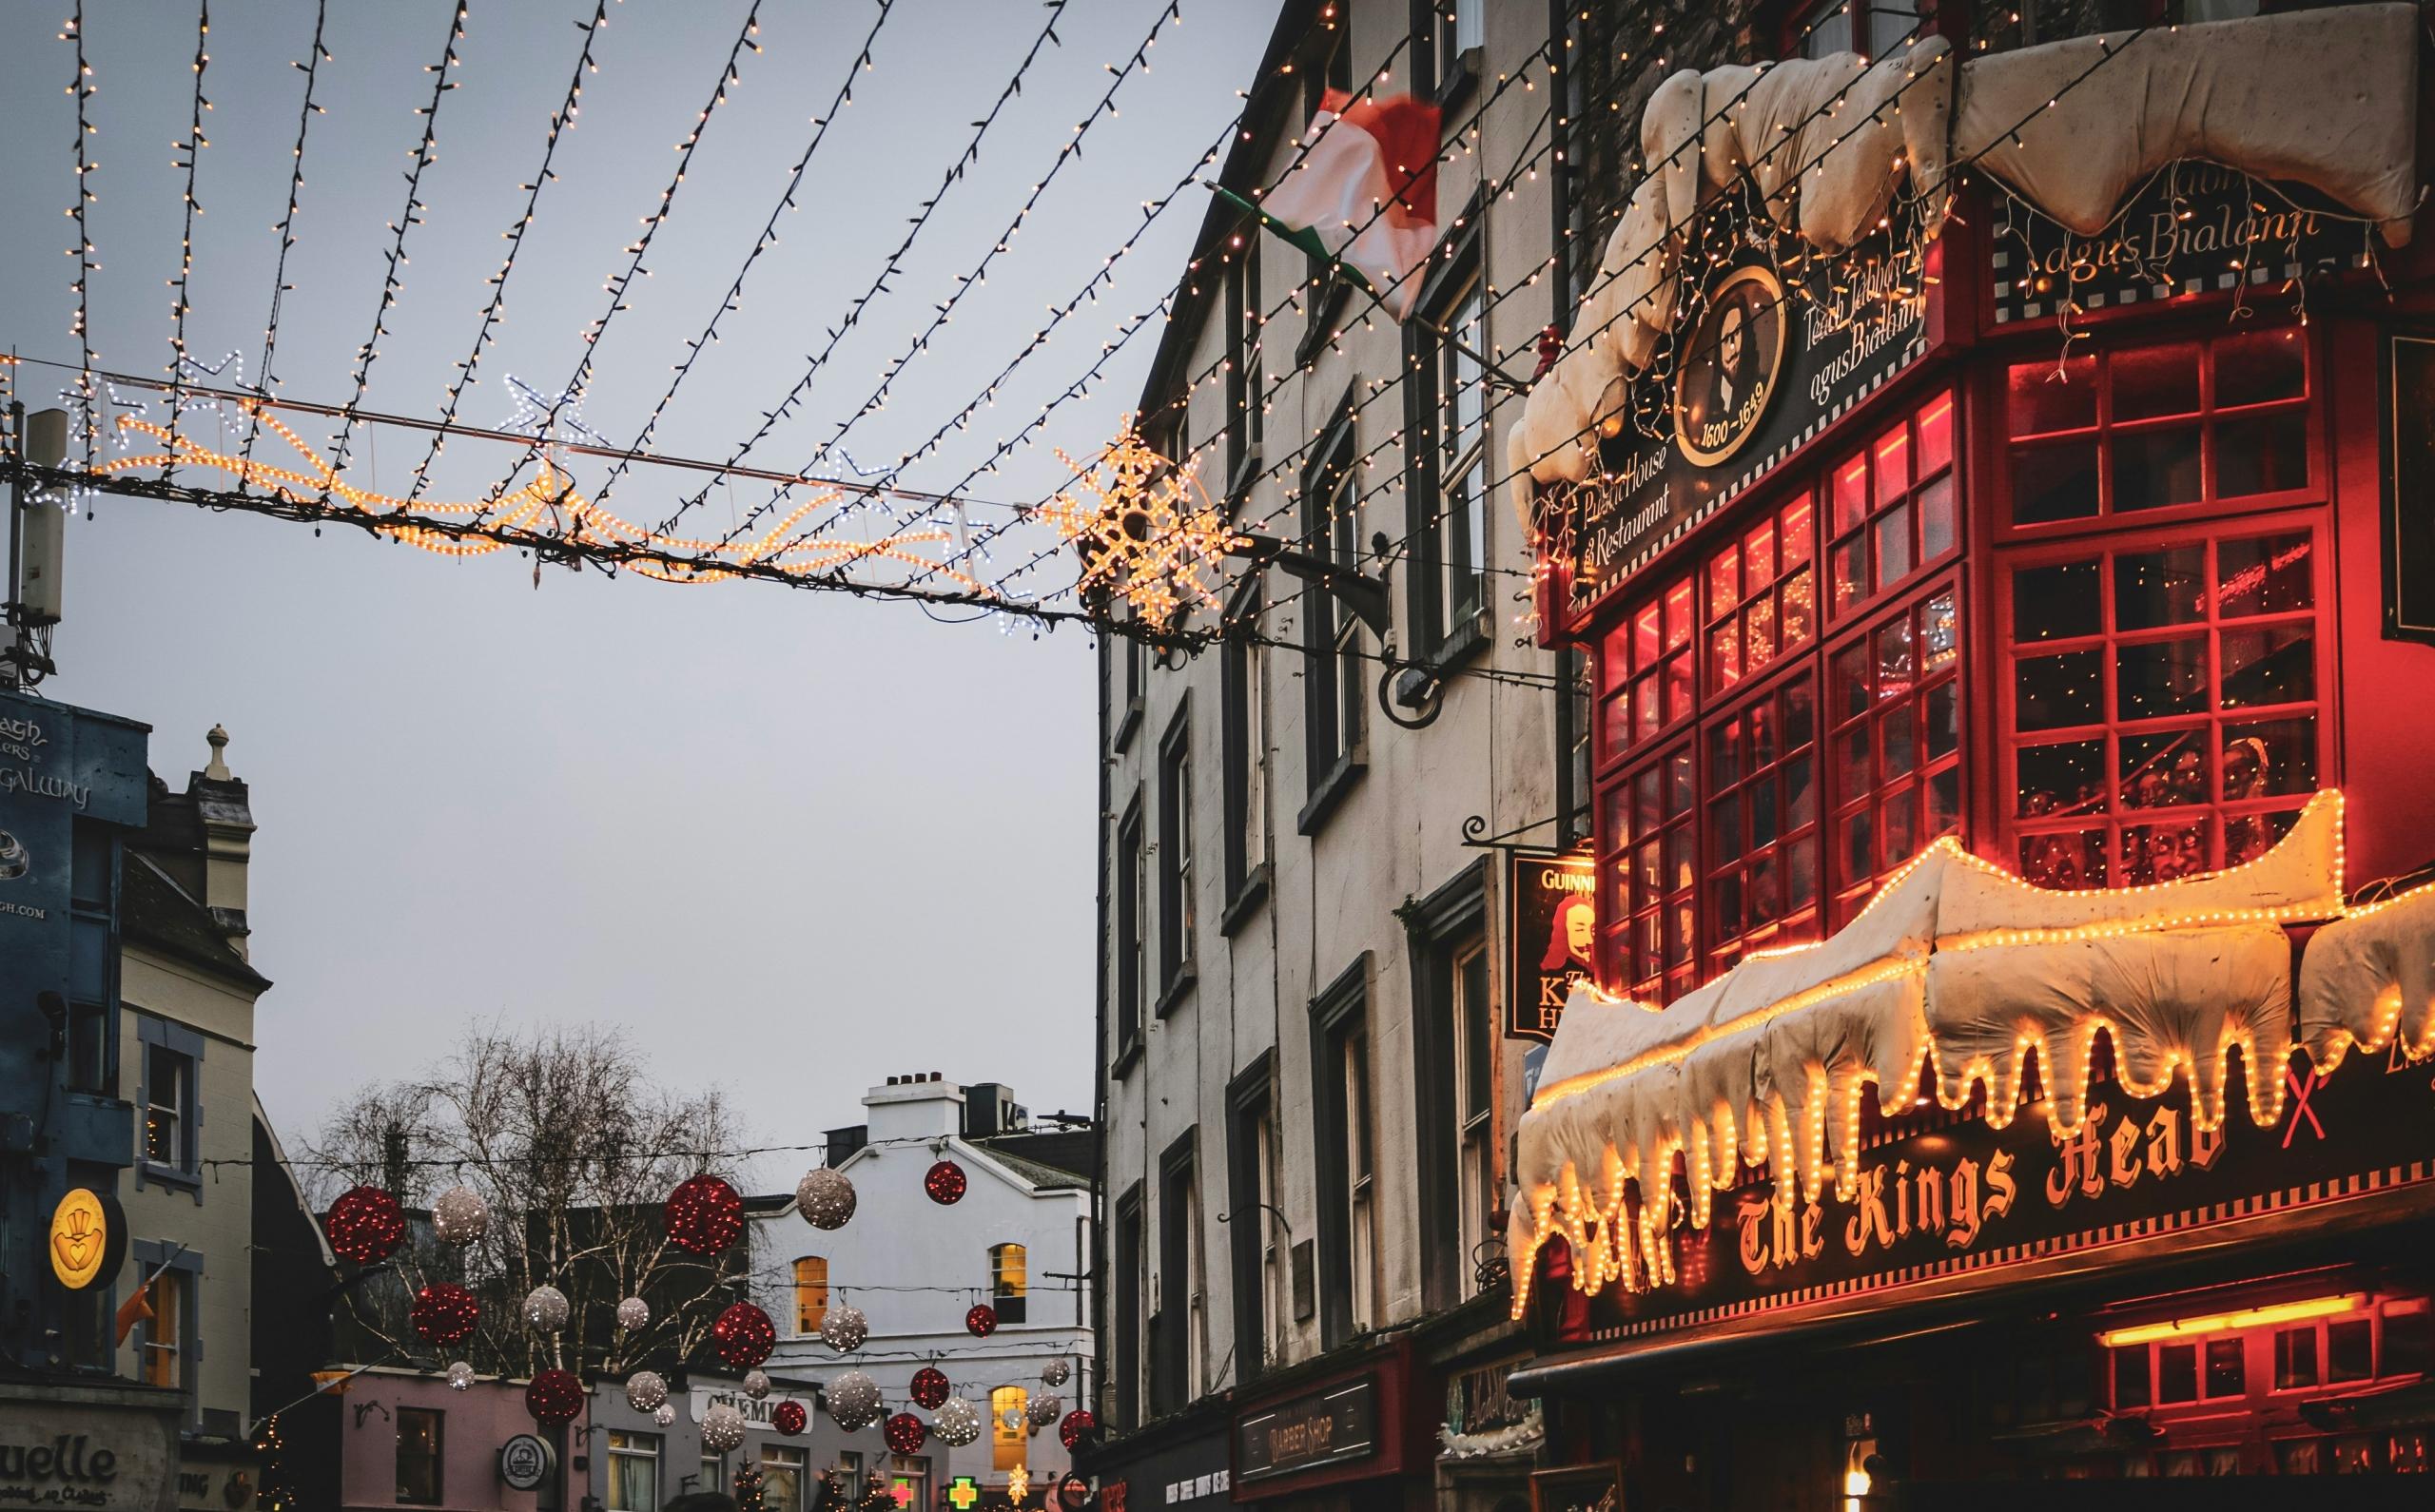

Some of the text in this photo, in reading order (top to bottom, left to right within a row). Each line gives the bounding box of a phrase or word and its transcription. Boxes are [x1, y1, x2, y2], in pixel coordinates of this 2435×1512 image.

[1736, 1191, 1825, 1276] The
[1843, 1148, 2016, 1258] Kings
[1307, 1414, 1334, 1455] SHOP
